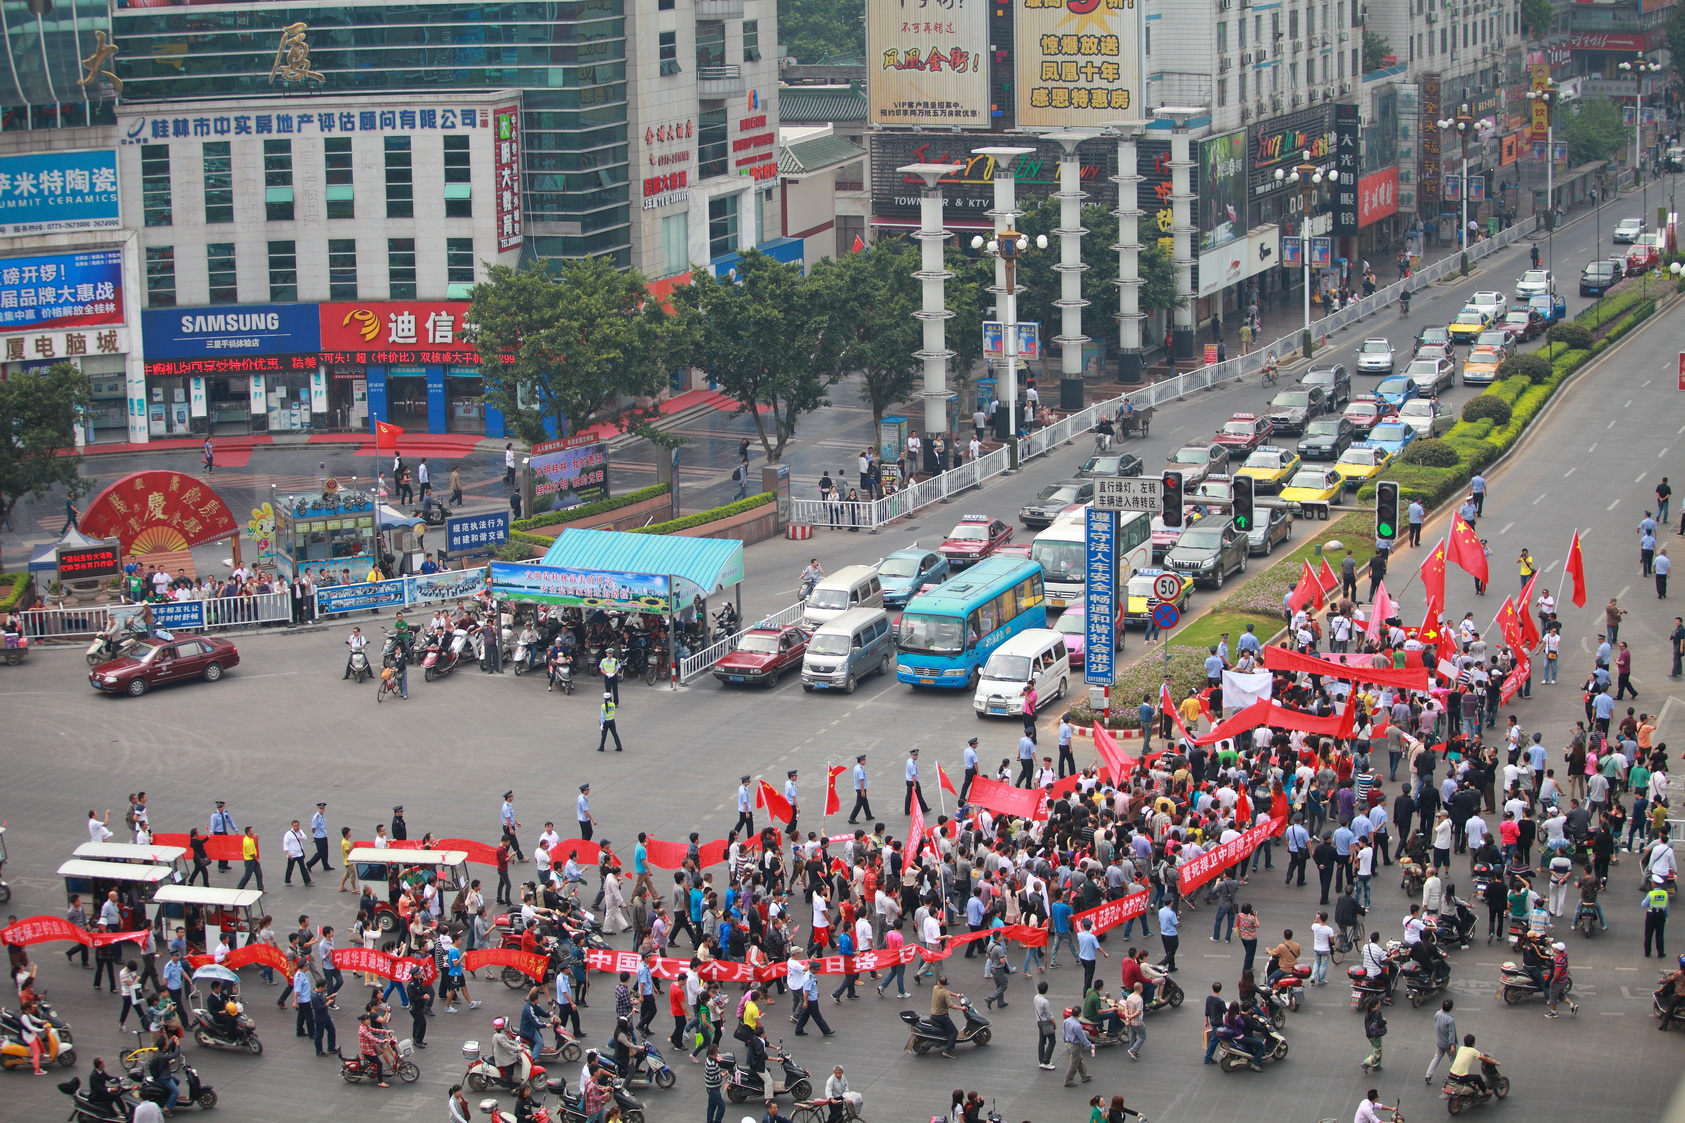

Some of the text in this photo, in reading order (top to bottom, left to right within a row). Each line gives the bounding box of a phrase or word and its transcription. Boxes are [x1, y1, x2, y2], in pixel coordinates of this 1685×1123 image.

[1040, 34, 1120, 56] 惊爆放送
[1040, 61, 1121, 82] 凤凰十年
[1031, 88, 1130, 109] 感恩特惠房
[151, 109, 477, 139] 桂林市中实房地产评估顾问有限公司
[1340, 133, 1355, 225] 大光明眼镜
[48, 193, 118, 205] CERAMICS
[968, 198, 989, 208] KTV
[0, 264, 65, 286] 磅开锣!
[41, 303, 116, 319] 价格解放全桂林
[181, 313, 279, 333] SAMSUNG
[6, 330, 119, 360] 厦电脑城
[206, 339, 260, 349] 三星手机体验店
[535, 453, 604, 478] 文明桂林 我的责任
[536, 478, 569, 496] 桂林文明
[572, 470, 604, 488] 我的光荣
[1099, 481, 1156, 494] 直行绿灯,左转
[1099, 495, 1160, 509] 车辆进入待转区。
[453, 518, 504, 533] 规范执法行为
[453, 530, 504, 545] 创建和谐交通
[1161, 580, 1175, 595] 50
